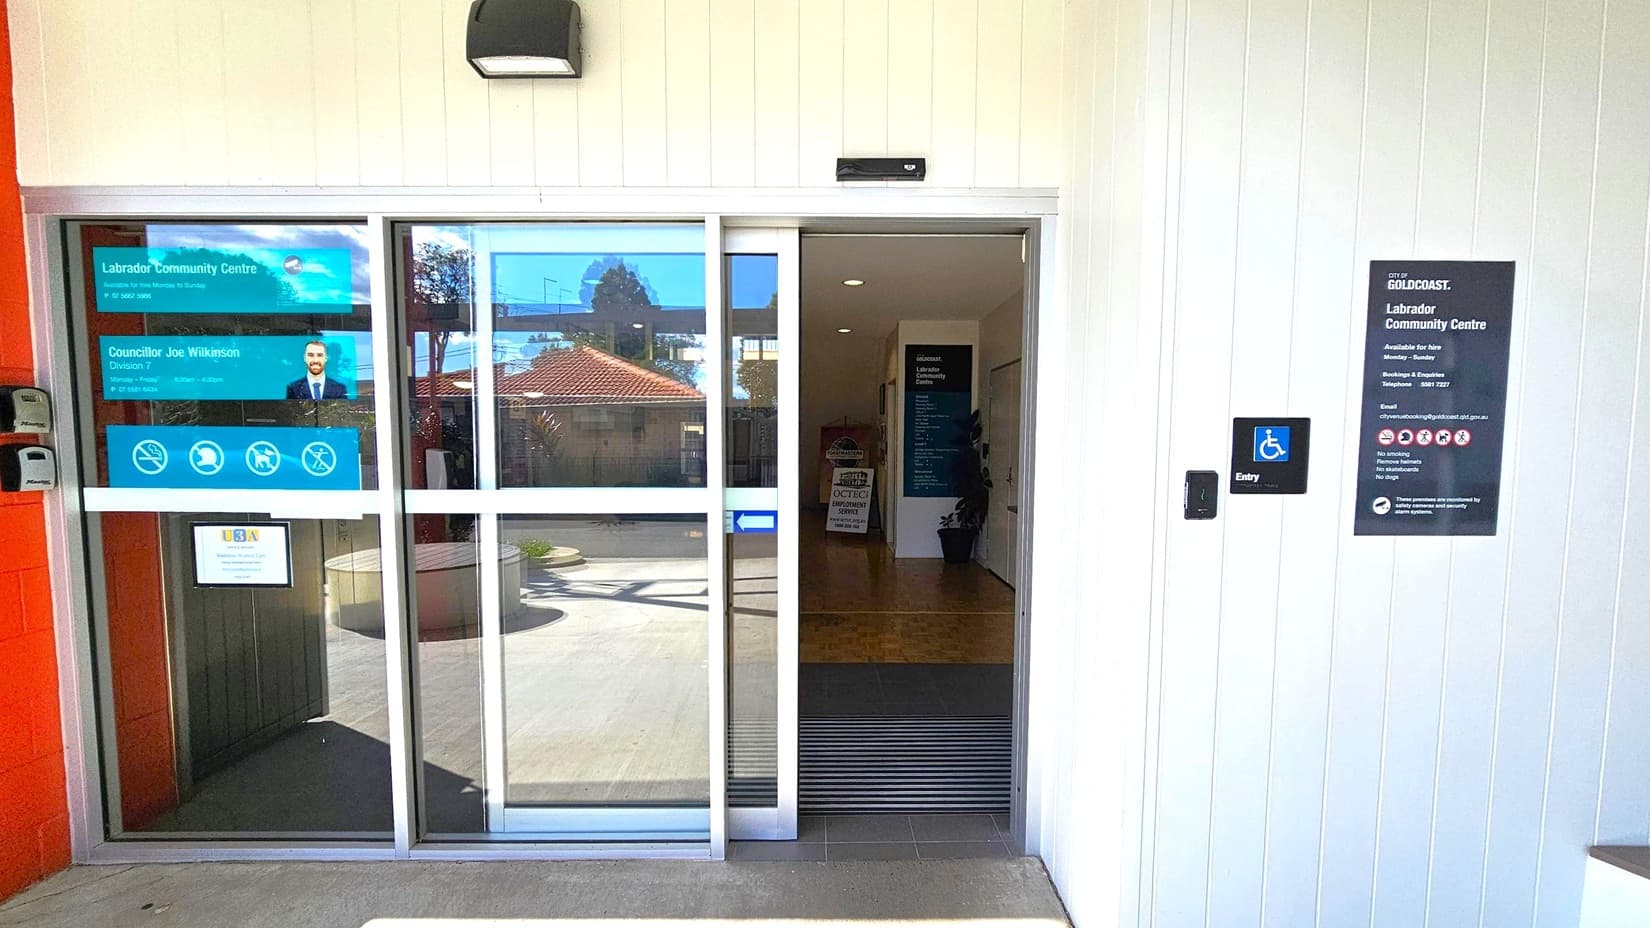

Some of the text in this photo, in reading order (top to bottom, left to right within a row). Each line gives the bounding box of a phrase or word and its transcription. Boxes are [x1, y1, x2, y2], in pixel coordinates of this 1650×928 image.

[102, 262, 257, 276] Labrador Community Centre
[1387, 279, 1452, 290] GOLDCOAST.
[1386, 303, 1437, 315] Labrador
[1385, 318, 1487, 332] Community Centre
[108, 346, 241, 359] Councillor Joe Wilkinson
[109, 361, 152, 370] Division 7
[1235, 472, 1260, 483] Entry
[833, 490, 866, 498] OCTEC
[832, 500, 867, 508] EMPLOYMENT
[838, 508, 859, 516] SERVICE
[221, 528, 260, 542] U3A
